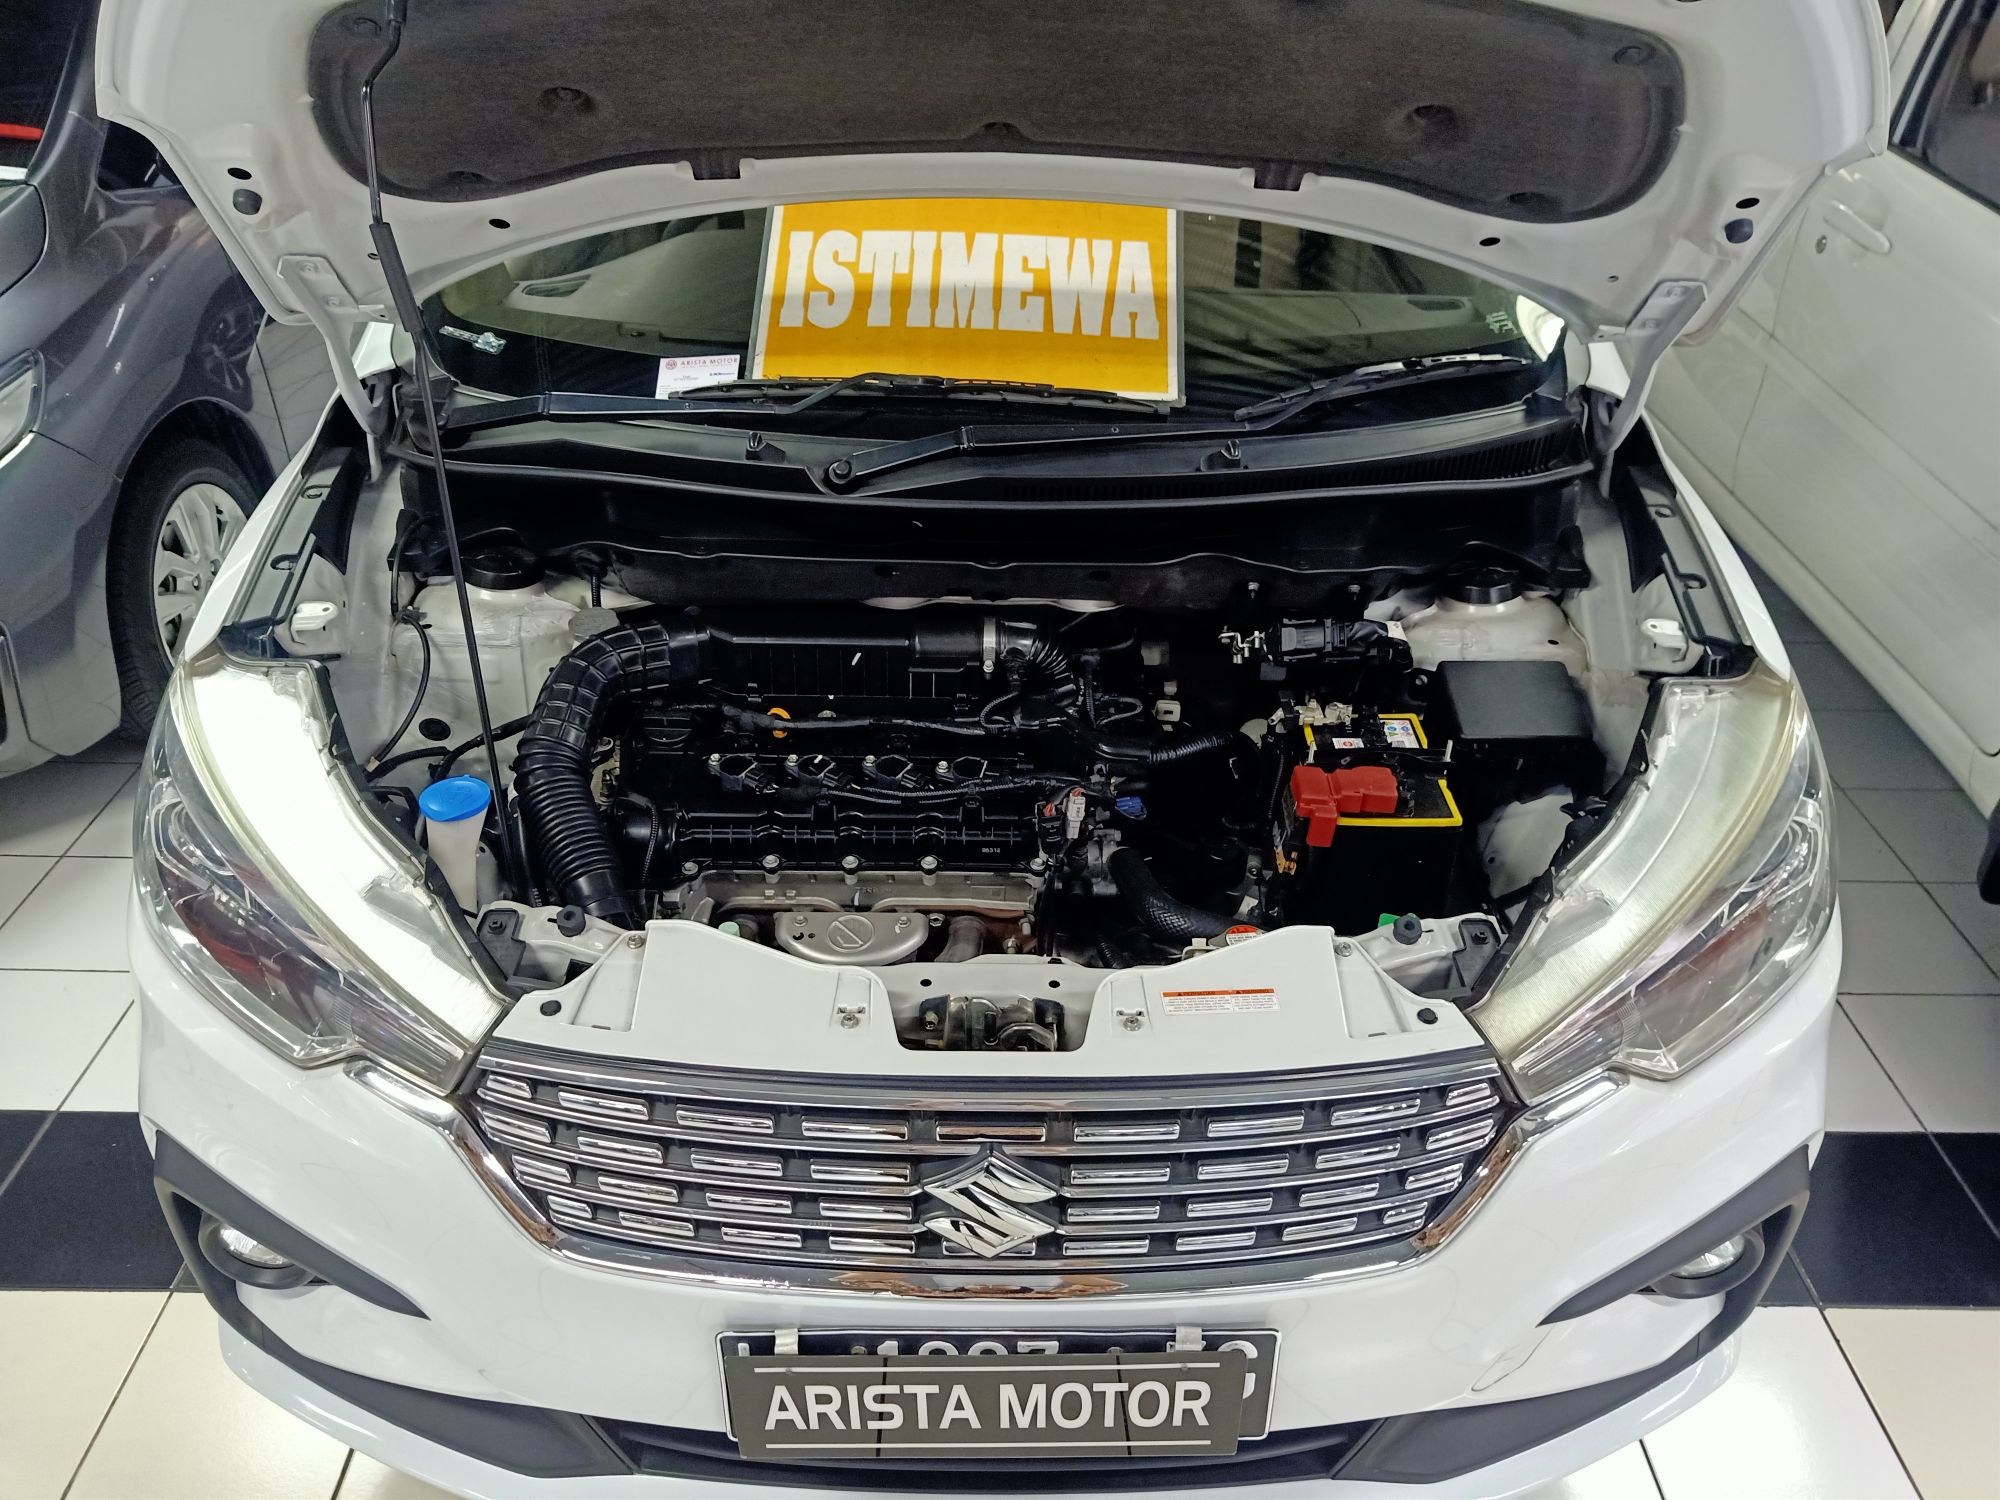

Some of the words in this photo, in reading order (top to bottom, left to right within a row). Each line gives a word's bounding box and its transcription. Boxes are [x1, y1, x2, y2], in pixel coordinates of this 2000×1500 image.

[779, 230, 1160, 340] ISTIMEWA
[764, 1383, 981, 1431] ARISTA
[999, 1380, 1212, 1429] MOTOR
